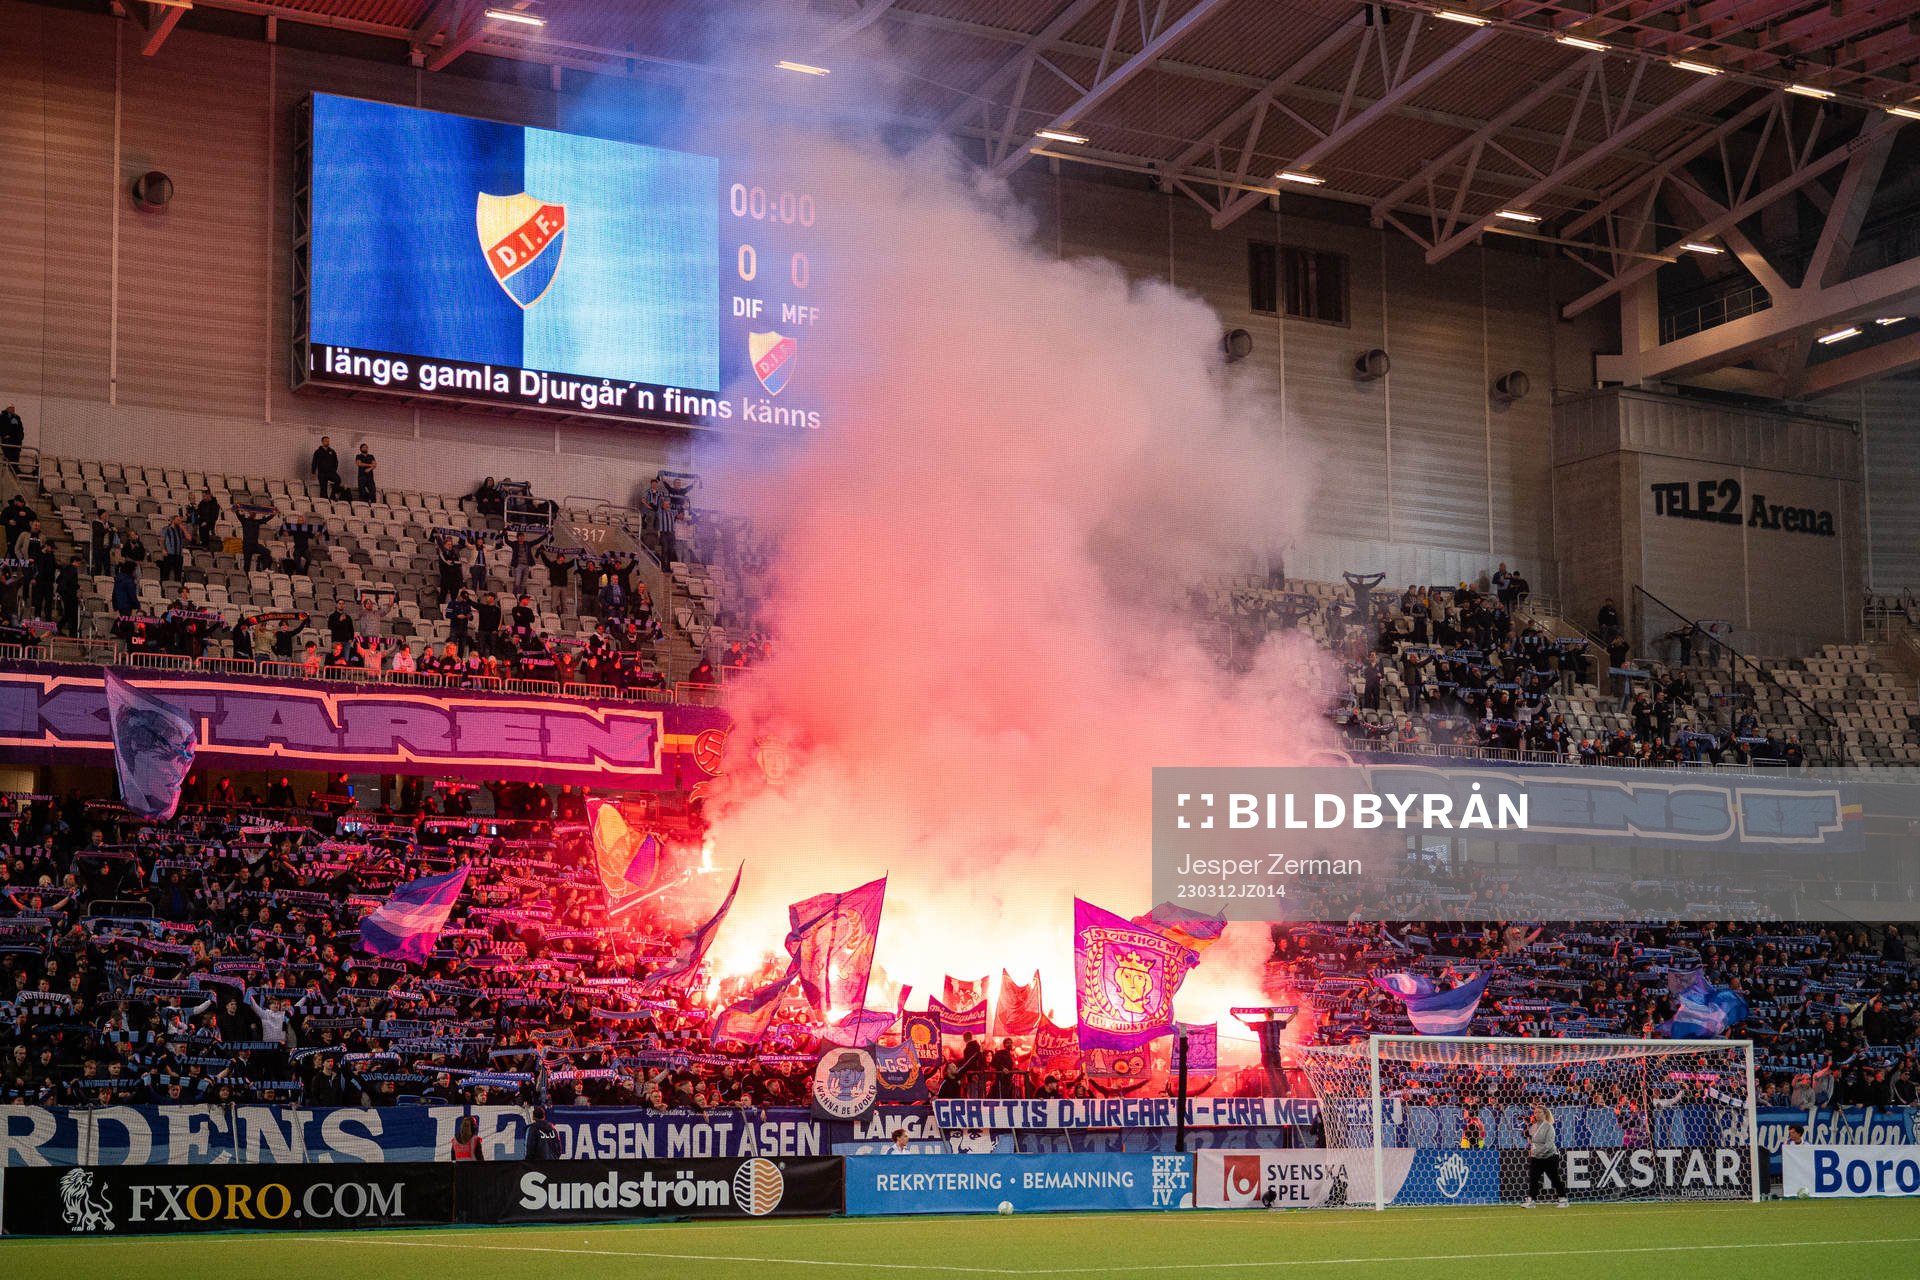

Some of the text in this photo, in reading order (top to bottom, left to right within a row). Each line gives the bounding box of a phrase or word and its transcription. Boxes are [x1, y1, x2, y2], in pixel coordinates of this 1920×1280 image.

[730, 183, 816, 228] 00:00
[738, 244, 810, 289] 0 0
[733, 296, 821, 328] DIF MFF
[324, 346, 409, 384] länge
[418, 358, 510, 395] gamla
[662, 385, 734, 421] finns
[742, 397, 822, 430] känns
[1651, 478, 1836, 537] TELE2 Arena
[1093, 929, 1177, 954] STOCKHOLM
[842, 1106, 852, 1115] BE
[854, 1084, 878, 1113] ADORED
[936, 1100, 1048, 1128] GRATTIS
[0, 1104, 385, 1167] RDENS
[667, 1122, 733, 1158] MOT
[854, 1109, 942, 1141] LÅNGA
[876, 1170, 1134, 1191] REKRYTERING BEMANNING
[1151, 1155, 1185, 1173] EFF
[1151, 1172, 1190, 1189] EKT
[1267, 1164, 1348, 1181] SVENSKA
[1566, 1149, 1741, 1188] EXSTAR
[1814, 1149, 1920, 1194] Boro
[128, 1182, 405, 1222] FXORO.COM
[519, 1170, 729, 1211] Sundström
